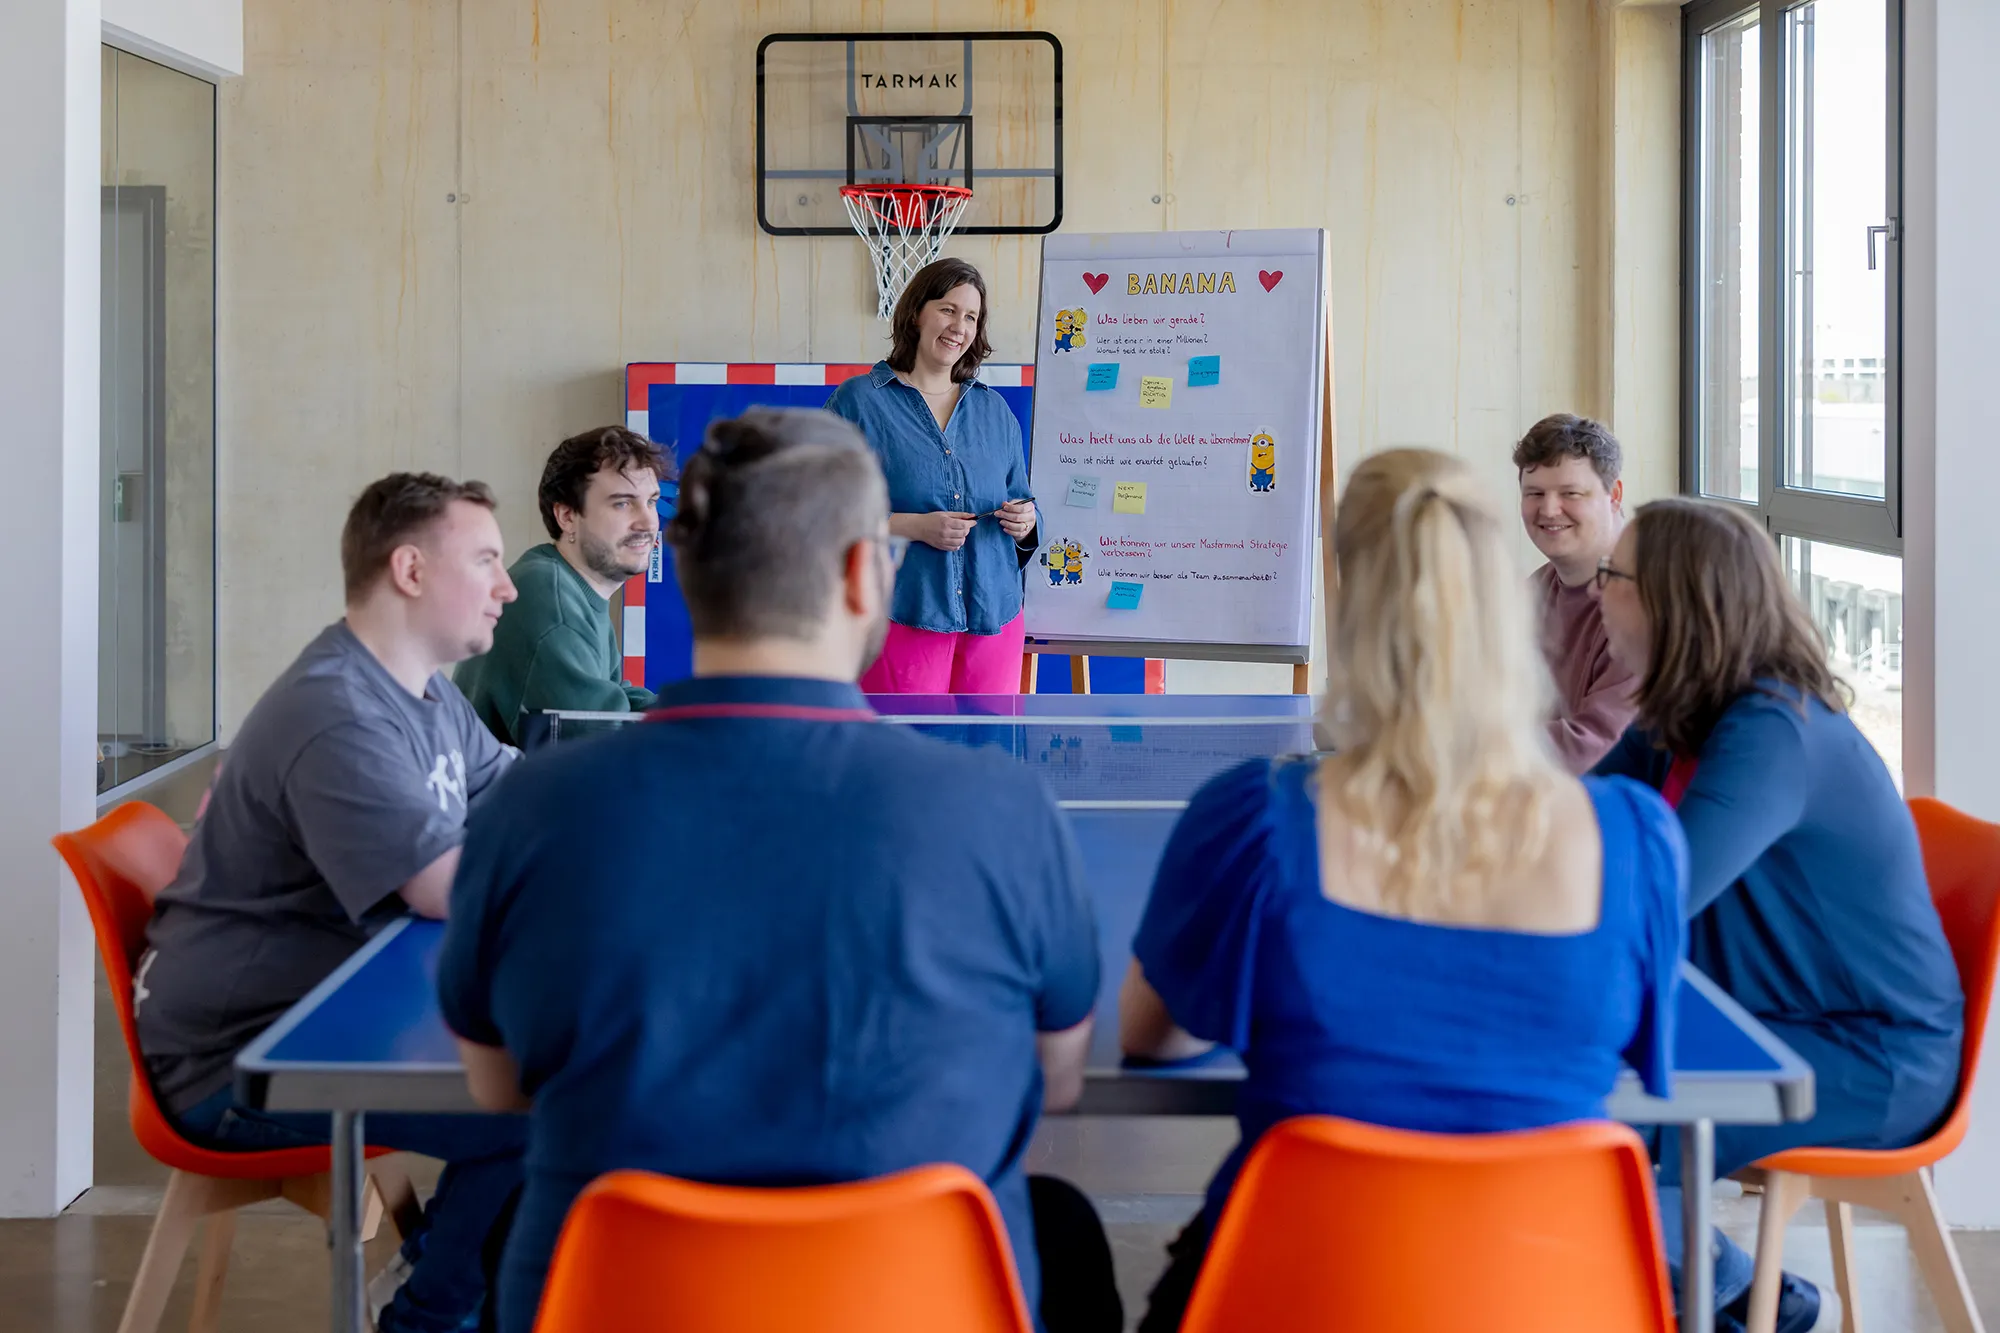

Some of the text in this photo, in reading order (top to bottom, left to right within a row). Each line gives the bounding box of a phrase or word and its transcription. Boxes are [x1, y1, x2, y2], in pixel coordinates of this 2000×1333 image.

[861, 73, 958, 89] TARMAK
[1127, 272, 1236, 295] BANANA
[1097, 313, 1205, 329] Was lieben wir gerade?
[1096, 336, 1110, 344] Wer
[1113, 335, 1122, 344] ist
[1060, 432, 1084, 444] Was
[1089, 431, 1113, 444] hielt
[1118, 436, 1136, 444] uns
[1138, 433, 1153, 444] ab
[1157, 432, 1171, 444] die
[1174, 432, 1195, 444] Welt
[1060, 454, 1207, 470] Was ist nicht wie erwartet gelaufen?
[1099, 535, 1118, 547] Wie
[1120, 534, 1151, 548] können
[1171, 541, 1196, 549] unsere
[1200, 538, 1245, 549] Mastermind
[1250, 539, 1288, 557] Strategie
[1097, 568, 1111, 577] Wie
[1114, 568, 1138, 578] können
[1139, 571, 1150, 579] wir
[1153, 569, 1173, 580] besser
[1176, 570, 1188, 579] als
[1190, 571, 1210, 580] Team
